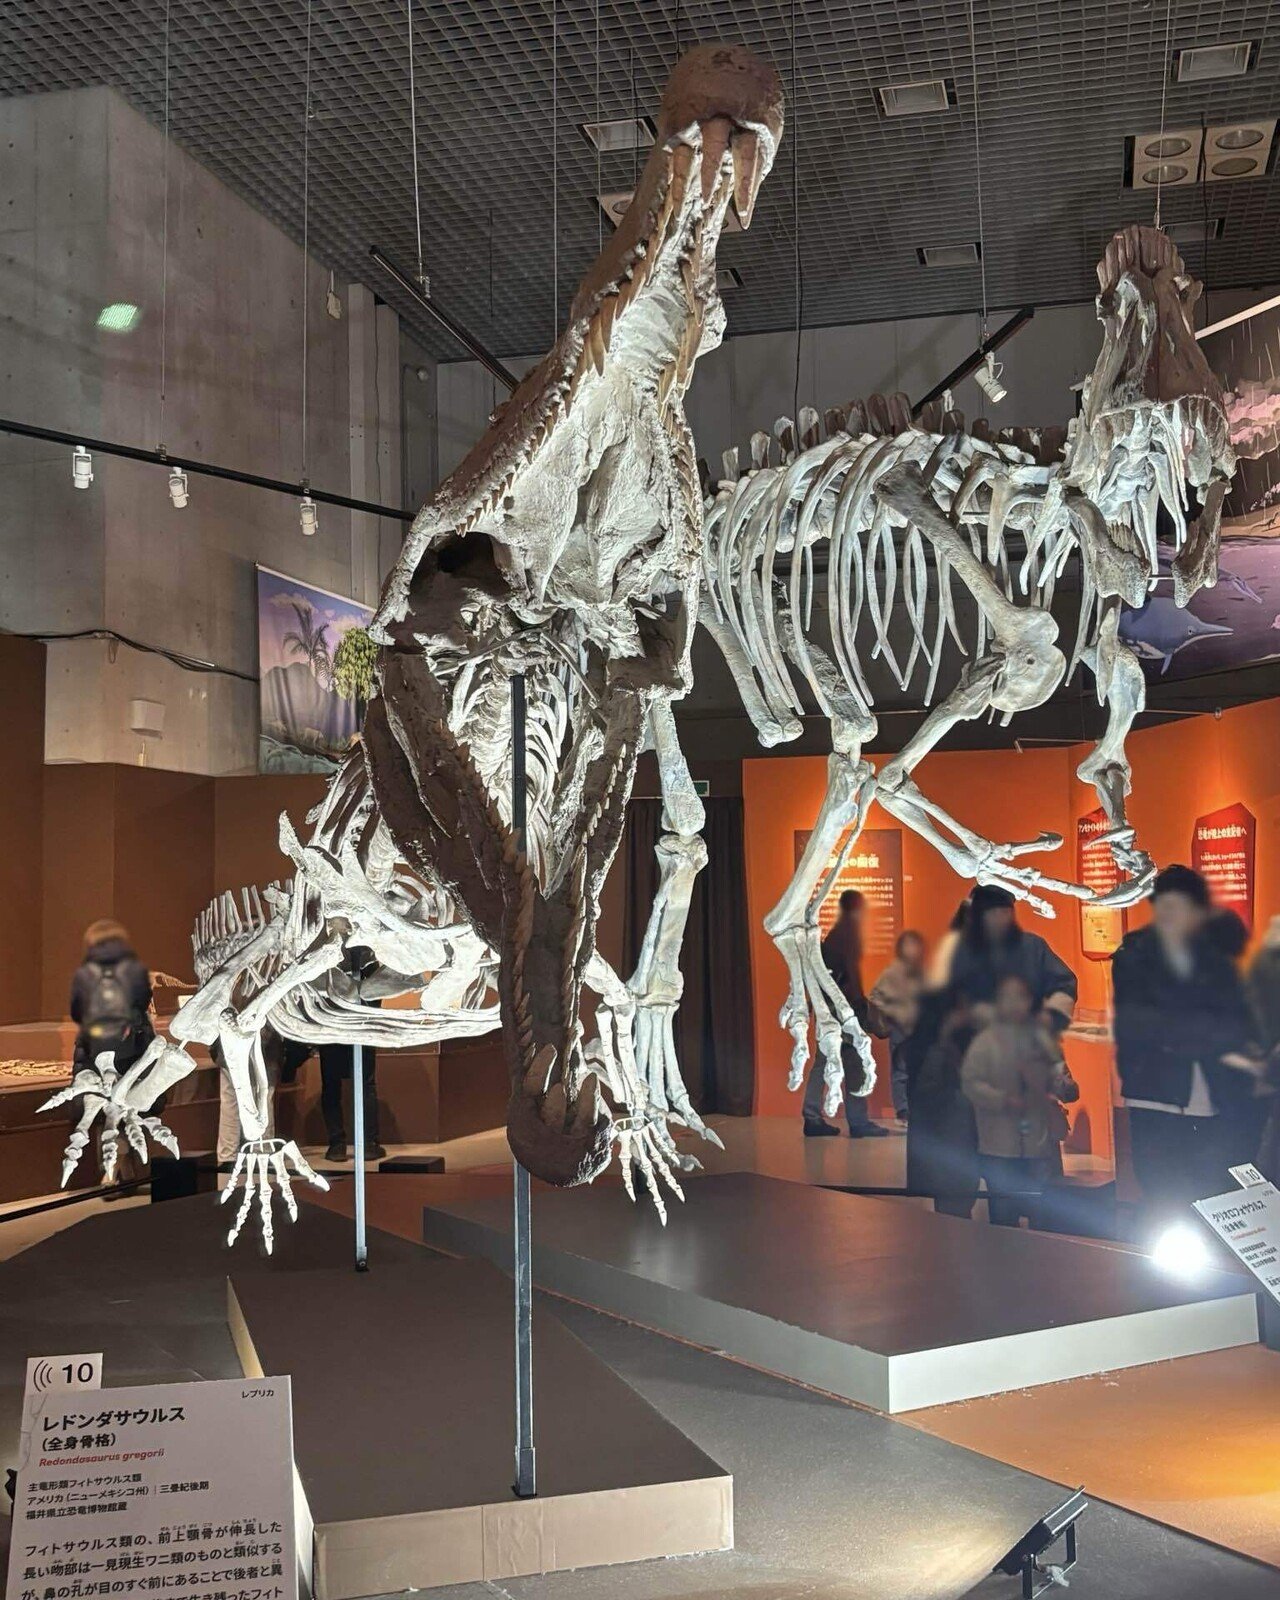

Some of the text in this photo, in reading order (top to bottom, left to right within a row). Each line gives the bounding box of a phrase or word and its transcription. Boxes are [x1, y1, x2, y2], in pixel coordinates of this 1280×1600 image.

[1246, 1169, 1261, 1182] 10
[62, 1362, 94, 1384] 10
[241, 1389, 275, 1399] レプリカ
[43, 1407, 186, 1432] レドンダサウルス
[42, 1433, 116, 1452] （全身骨格）
[39, 1448, 165, 1467] Redondasaurus gregorii
[27, 1473, 142, 1493] 主竜形類フィトサウルス類
[26, 1501, 128, 1520] 福井県立恐竜博物館蔵
